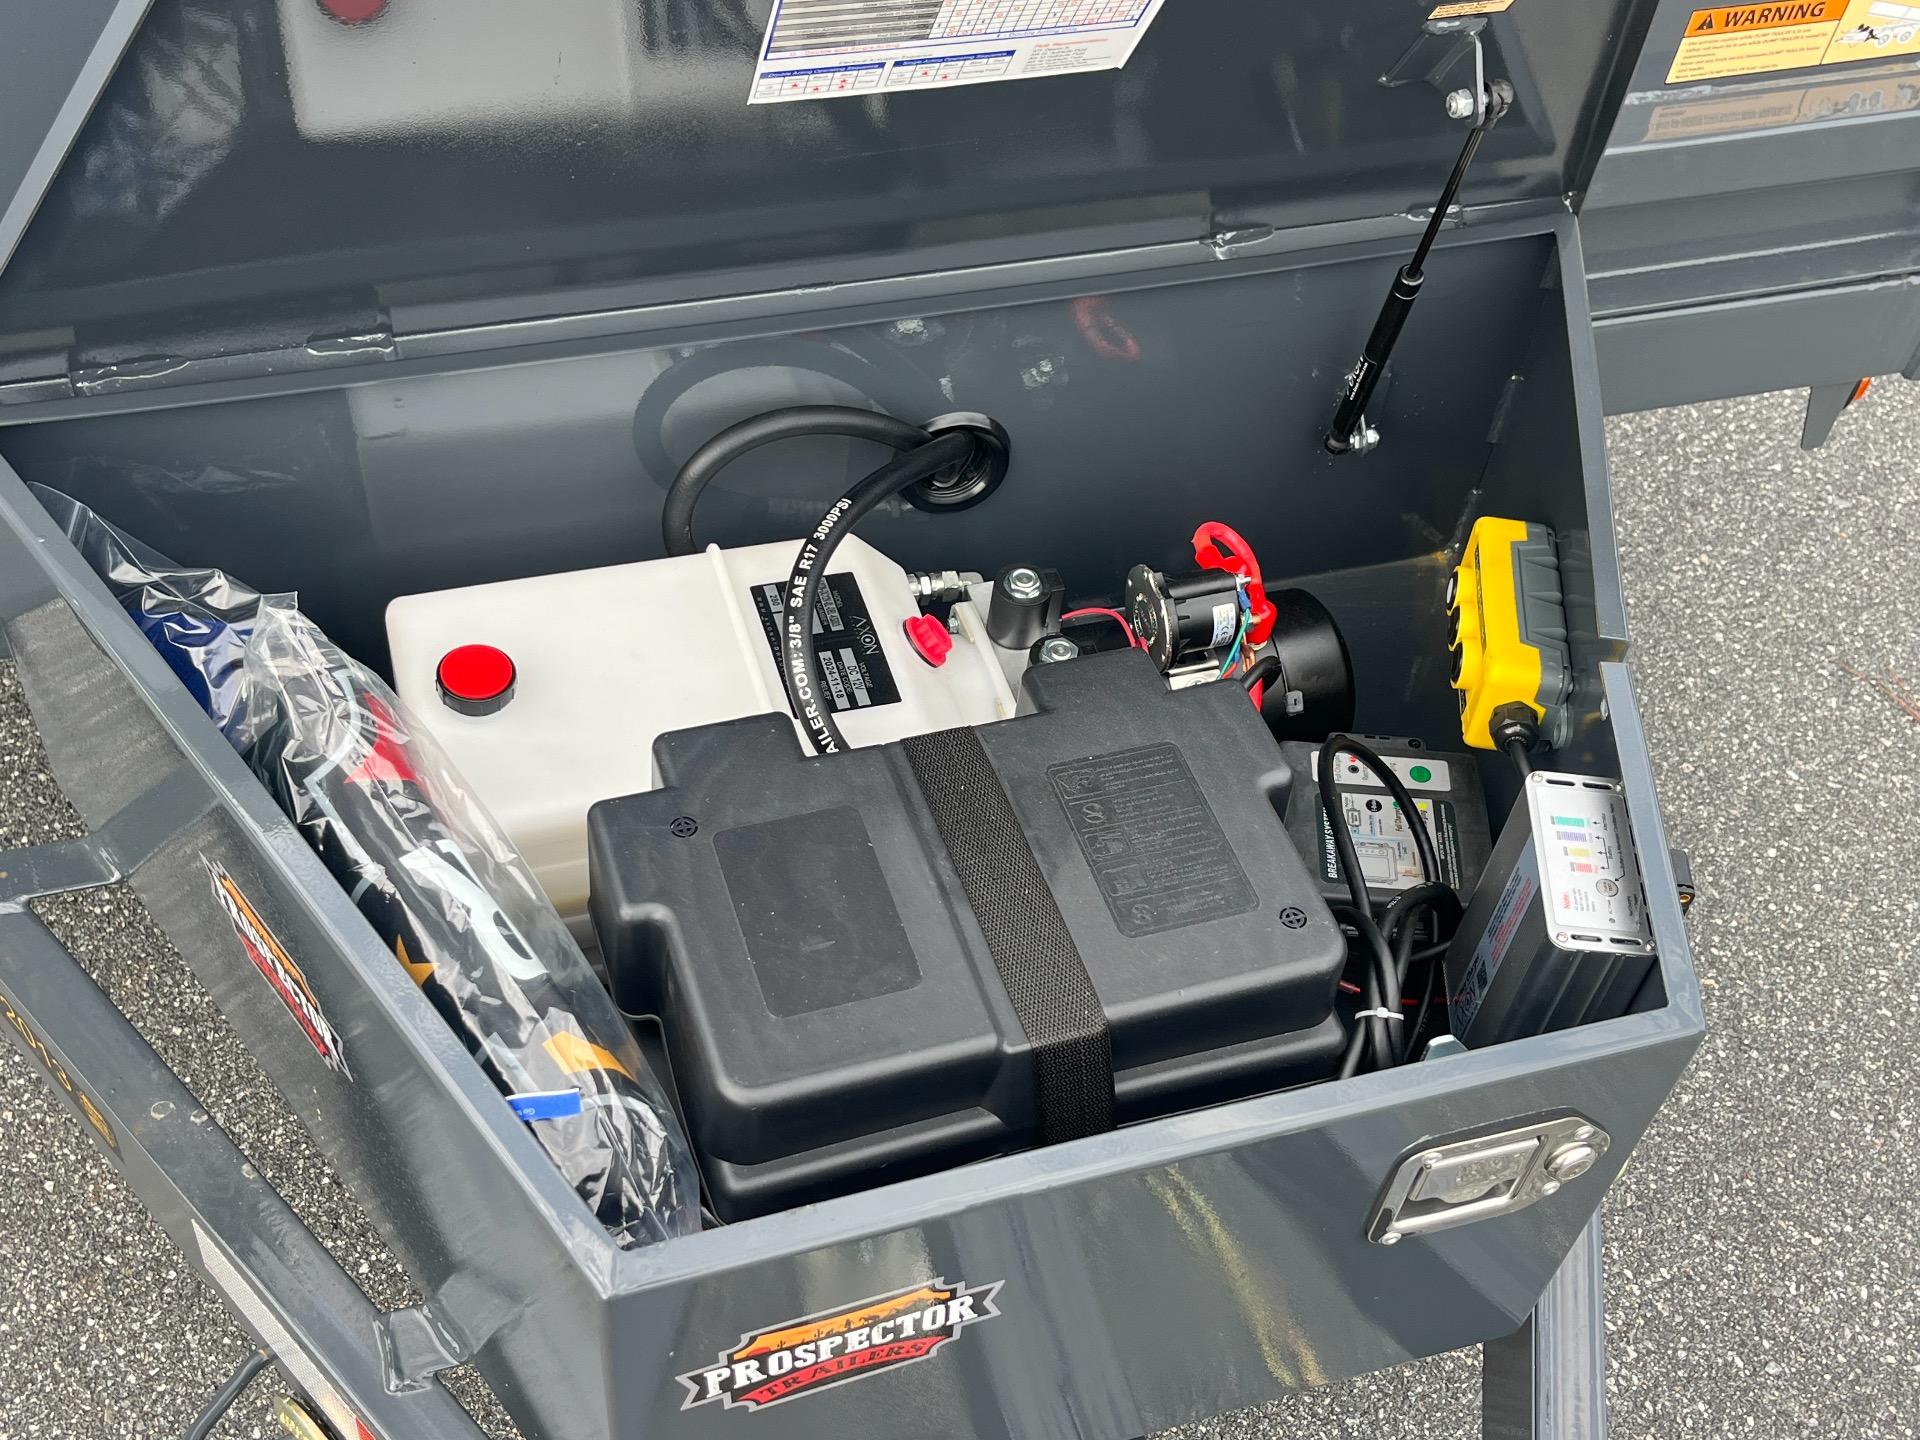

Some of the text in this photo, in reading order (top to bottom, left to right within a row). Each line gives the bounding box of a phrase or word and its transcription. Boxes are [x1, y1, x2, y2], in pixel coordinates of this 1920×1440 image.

[1724, 1, 1826, 27] WARNING
[790, 575, 807, 608] SAE
[799, 544, 818, 570] R17
[813, 498, 852, 541] 3000PSI
[851, 615, 879, 653] AXON
[822, 657, 844, 698] 2024-11-18
[847, 664, 864, 690] DC 12V
[857, 662, 872, 688] VOLTAGE
[1324, 834, 1337, 878] BREAKAWAY
[703, 1295, 978, 1399] PROSPECTOR
[760, 1341, 928, 1398] TRAILERS
